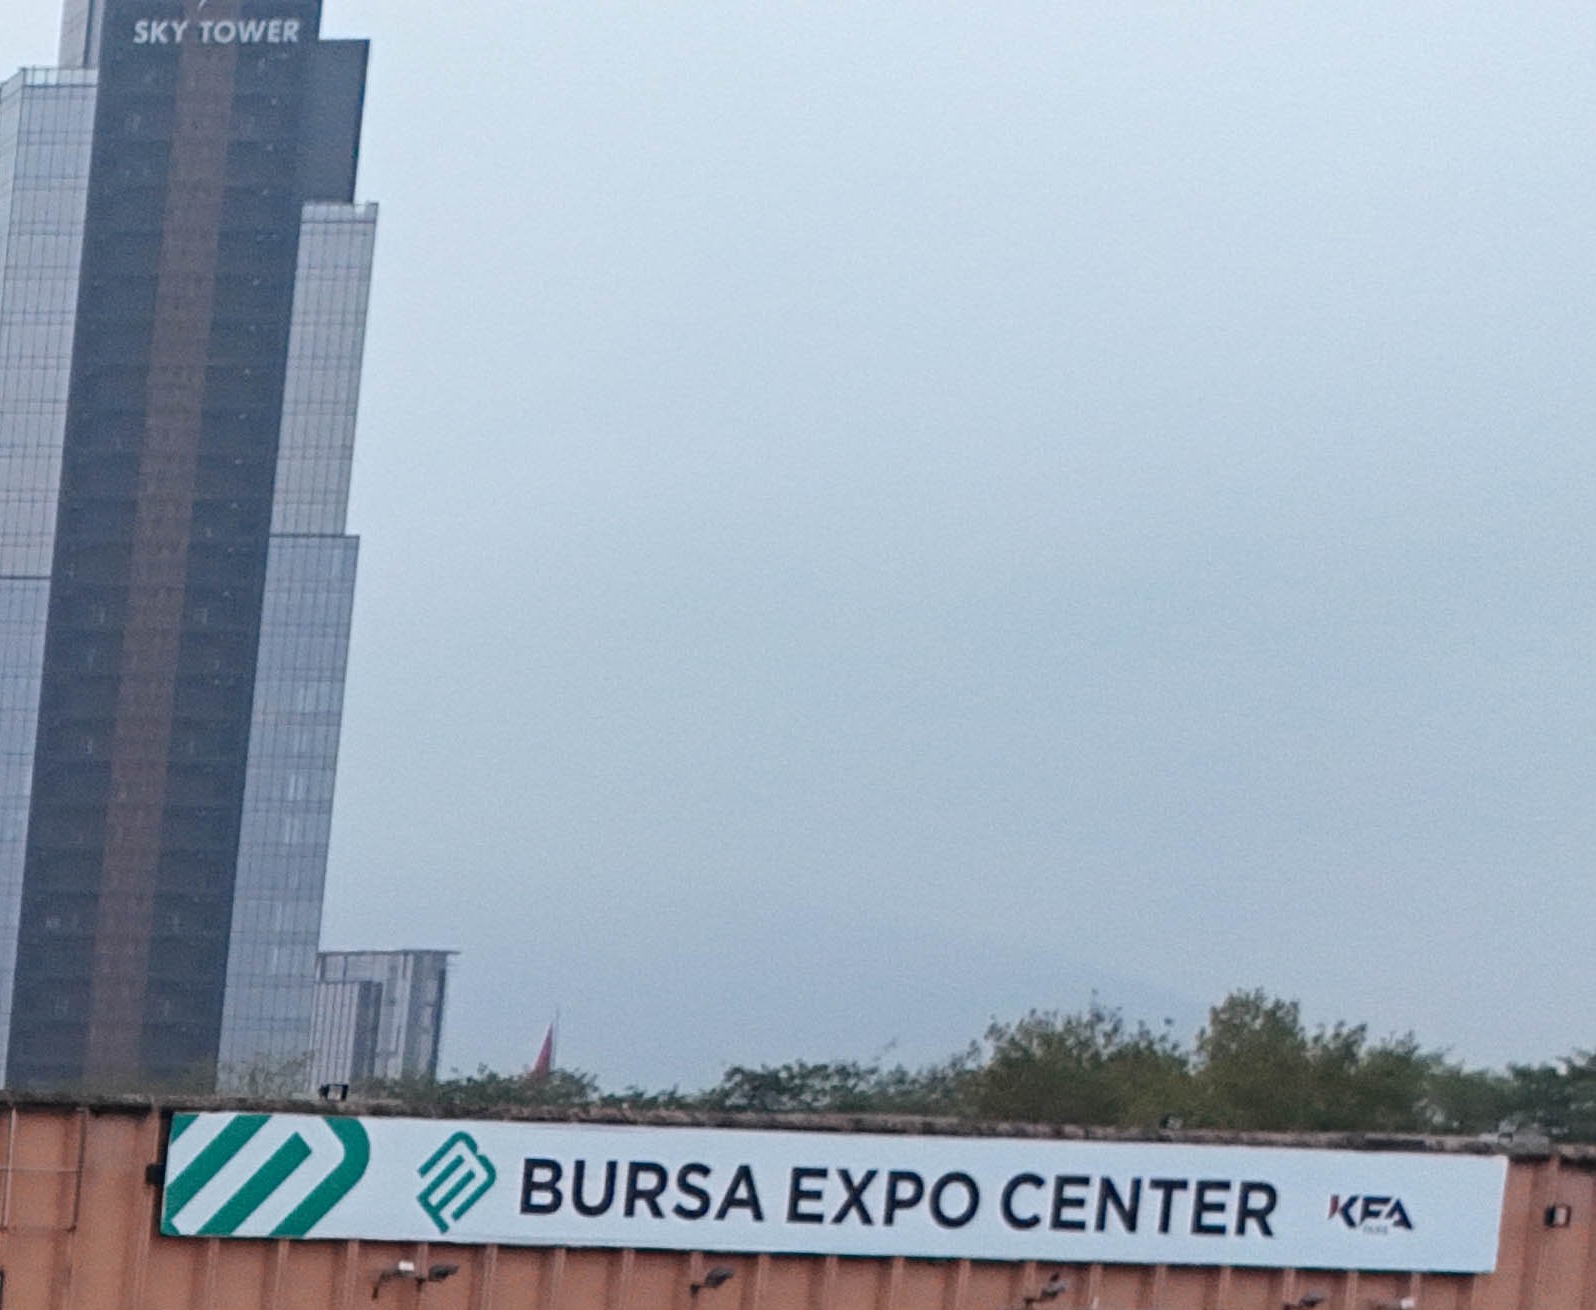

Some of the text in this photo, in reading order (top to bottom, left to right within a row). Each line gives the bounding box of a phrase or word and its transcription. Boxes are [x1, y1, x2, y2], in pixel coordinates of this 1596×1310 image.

[133, 19, 300, 44] SKY TOWER
[519, 1156, 1277, 1239] BURSA EXPO CENTER
[1327, 1195, 1413, 1230] KFA
